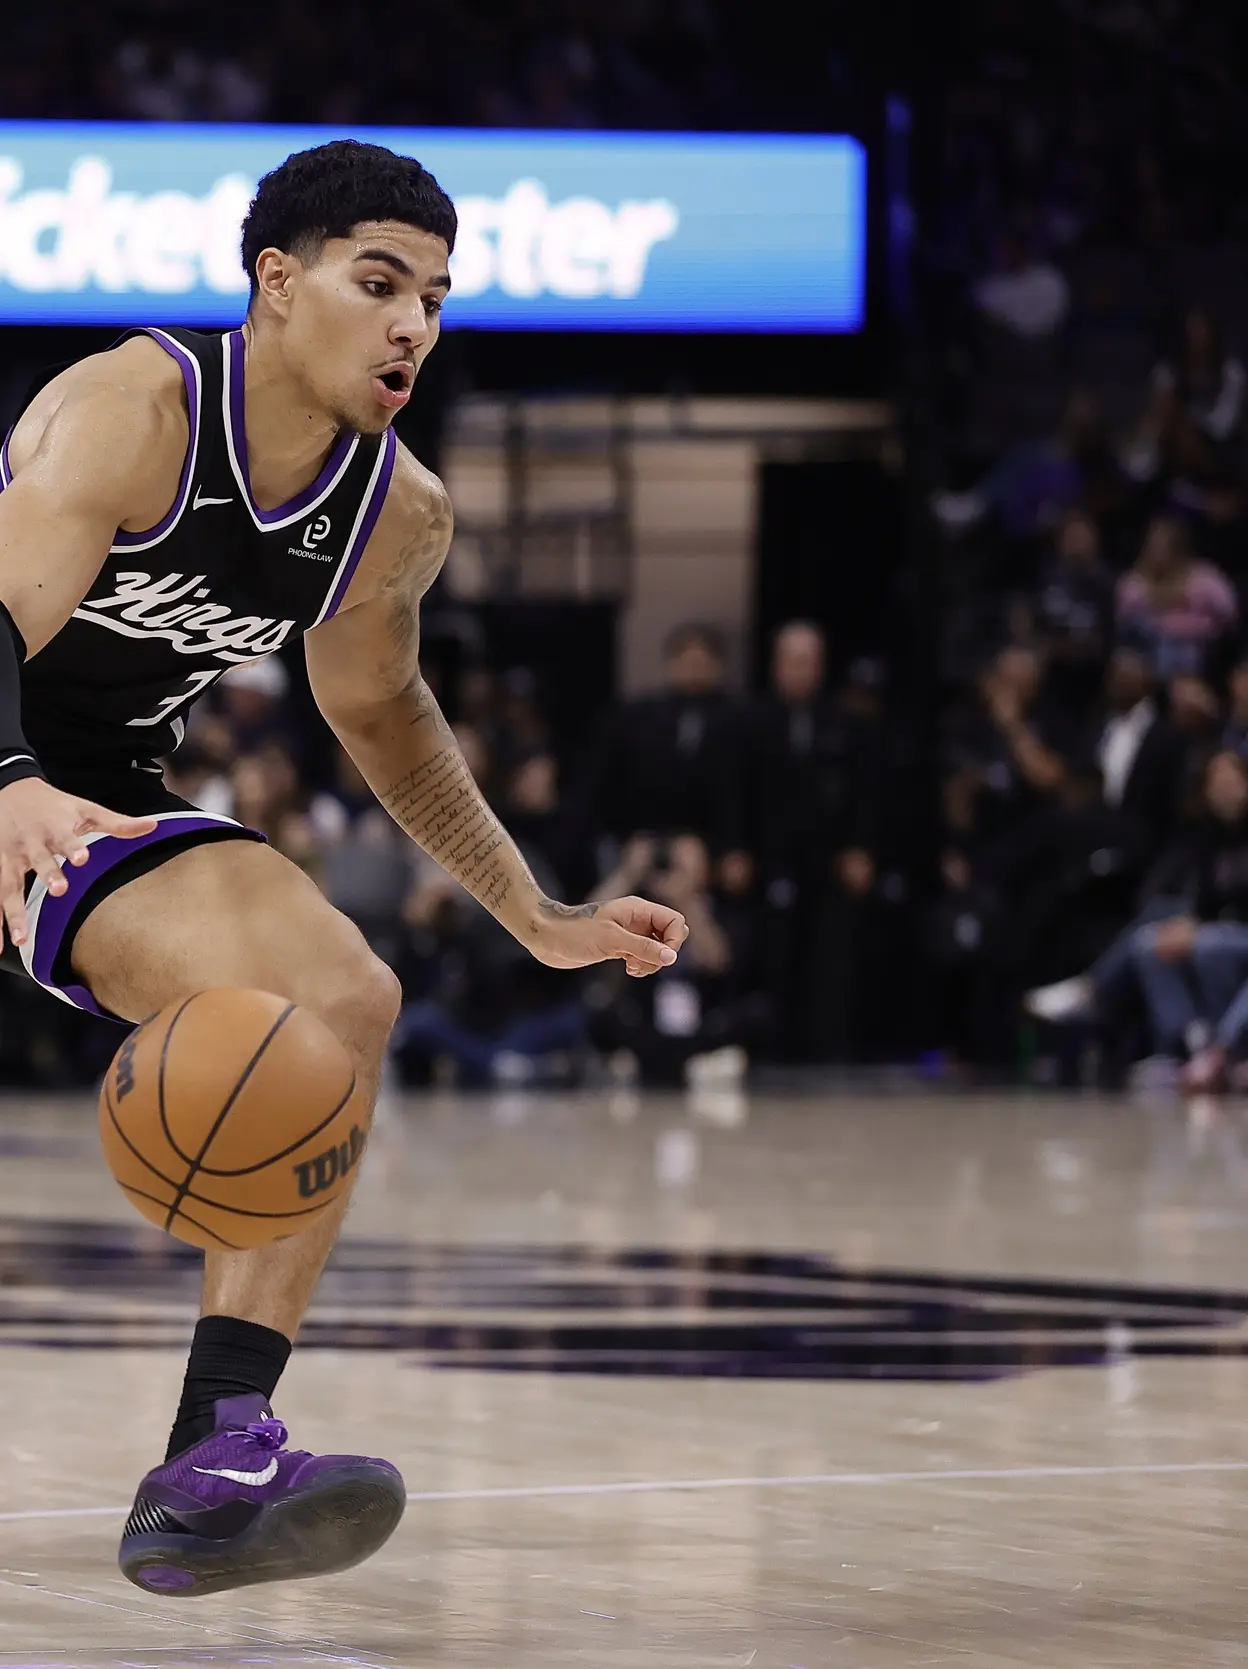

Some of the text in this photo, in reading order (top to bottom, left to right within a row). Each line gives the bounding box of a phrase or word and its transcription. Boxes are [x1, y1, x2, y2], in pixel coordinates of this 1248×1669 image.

[287, 547, 333, 563] PHOONG LAW
[72, 571, 297, 656] Kings
